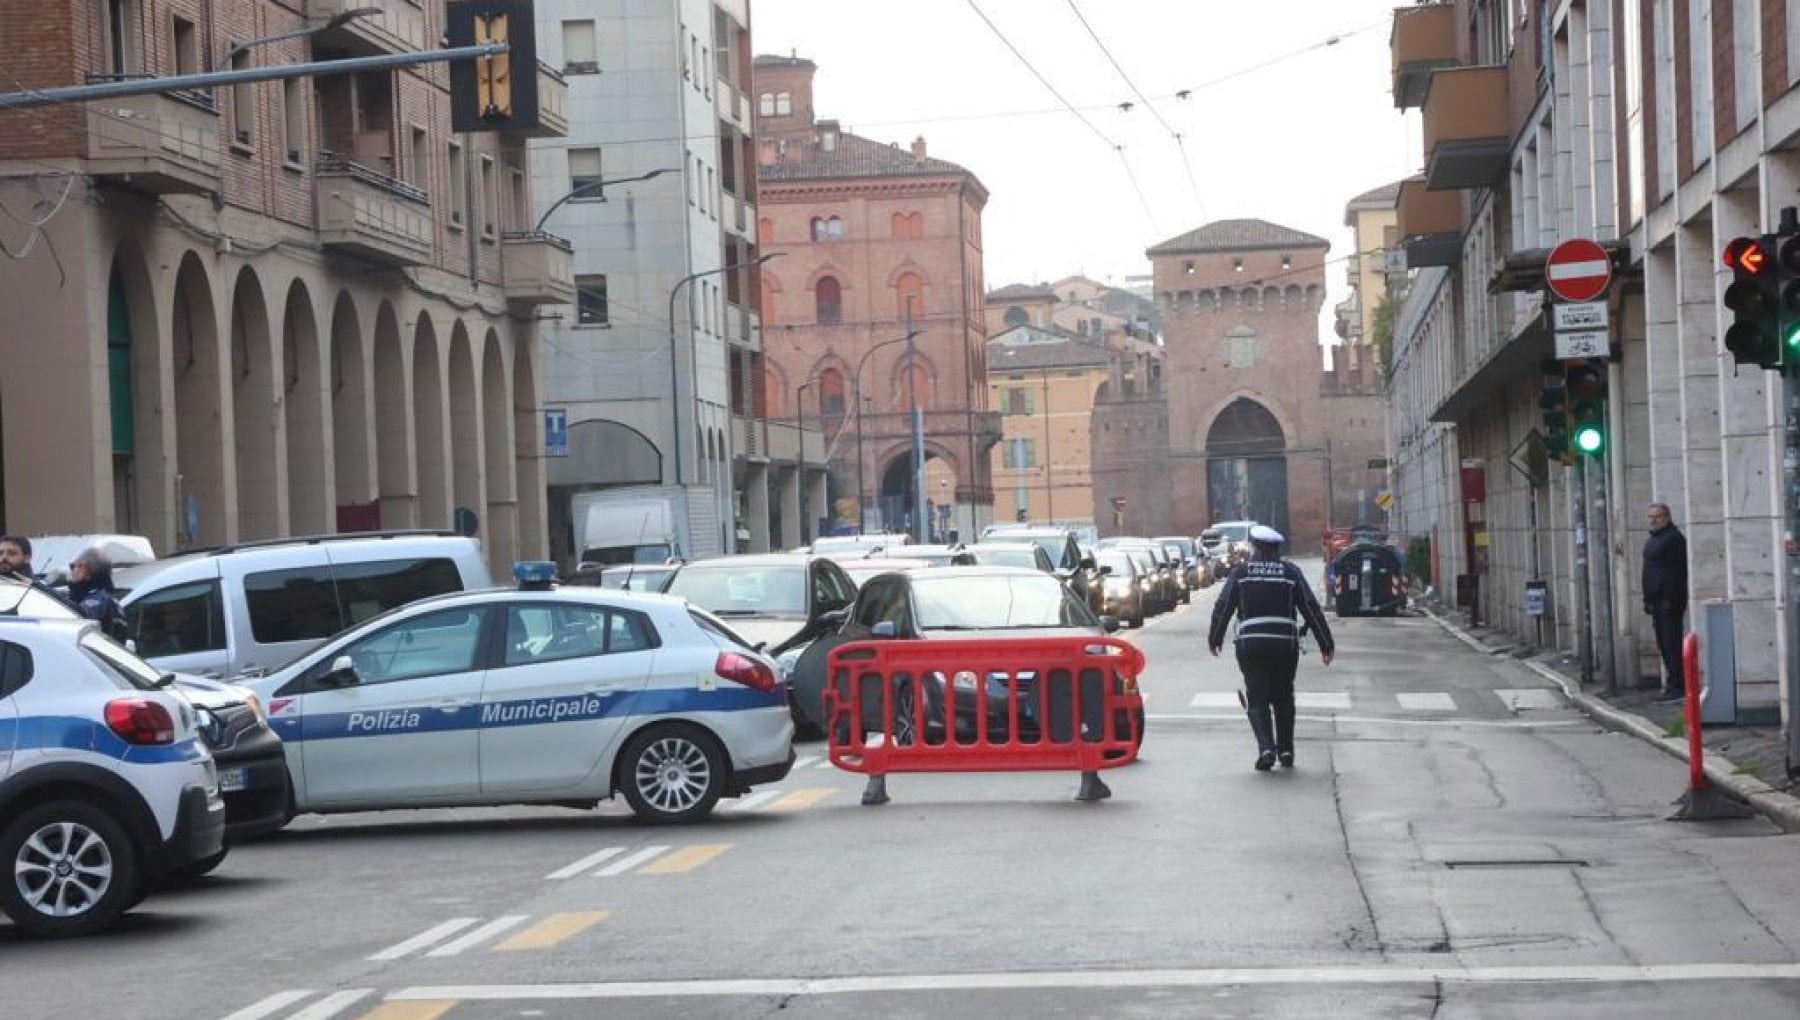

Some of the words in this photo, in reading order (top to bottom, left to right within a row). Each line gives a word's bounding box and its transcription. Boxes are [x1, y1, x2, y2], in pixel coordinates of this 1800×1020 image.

[1247, 568, 1284, 576] LOCALE
[347, 710, 420, 731] Polizia
[481, 698, 601, 723] Municipale
